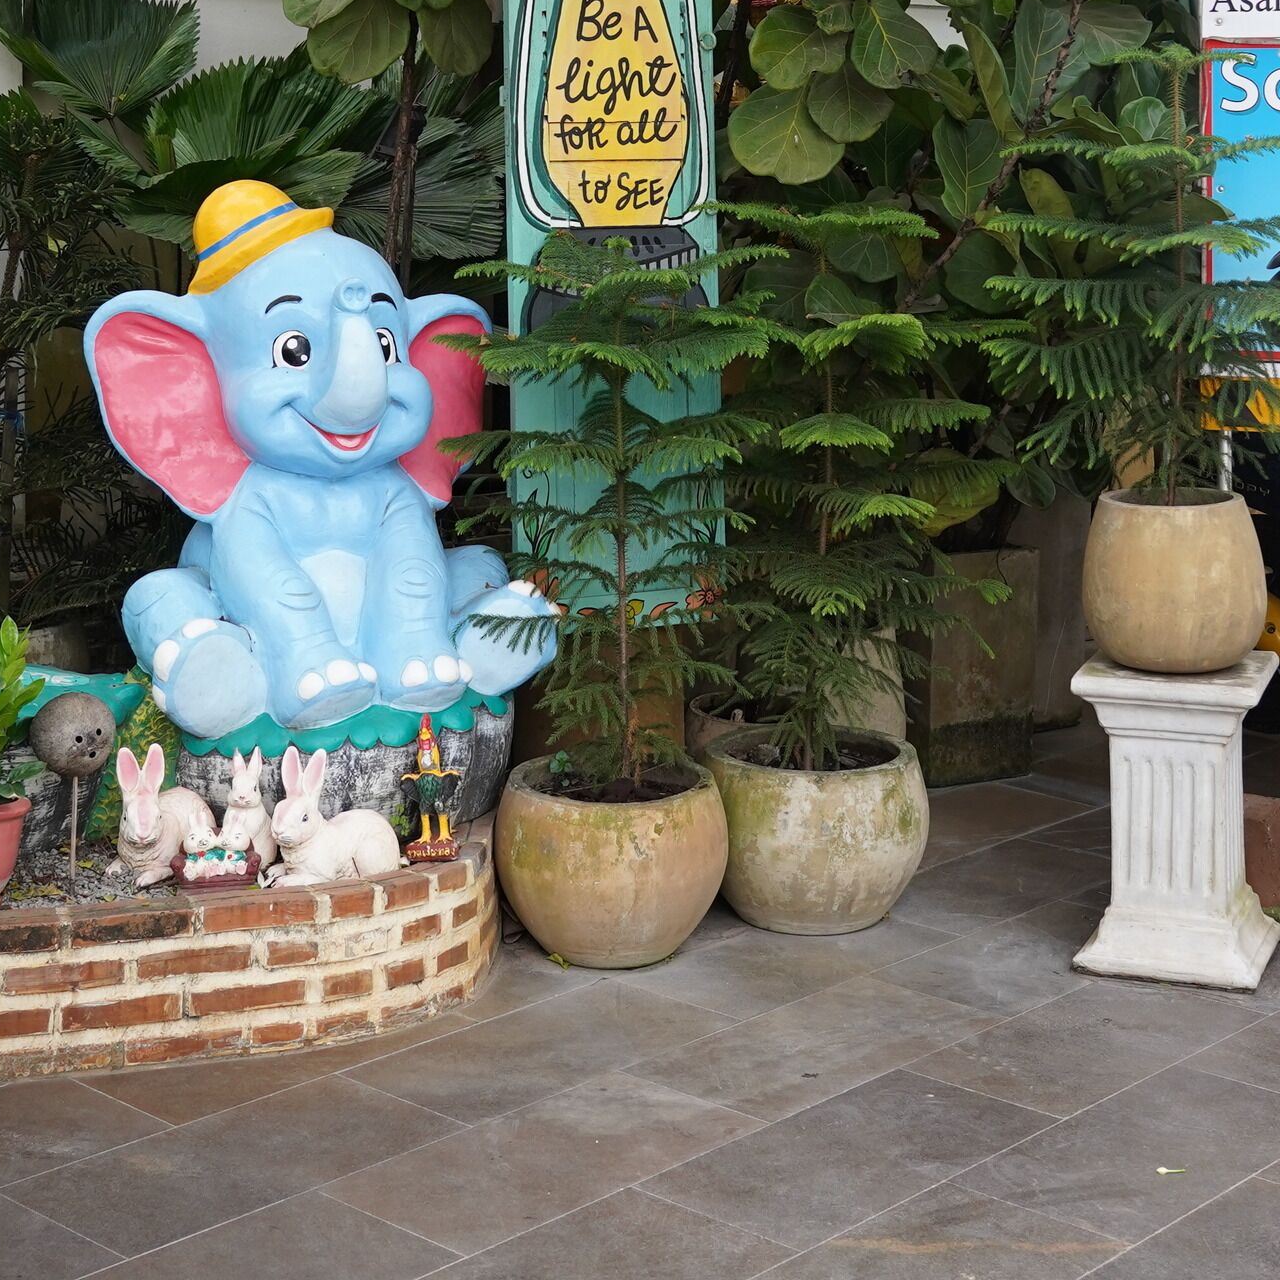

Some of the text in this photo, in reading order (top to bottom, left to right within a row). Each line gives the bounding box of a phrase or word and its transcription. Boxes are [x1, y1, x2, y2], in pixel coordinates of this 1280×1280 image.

[633, 5, 659, 44] A
[555, 55, 677, 115] light
[616, 107, 678, 145] all
[578, 169, 611, 204] to
